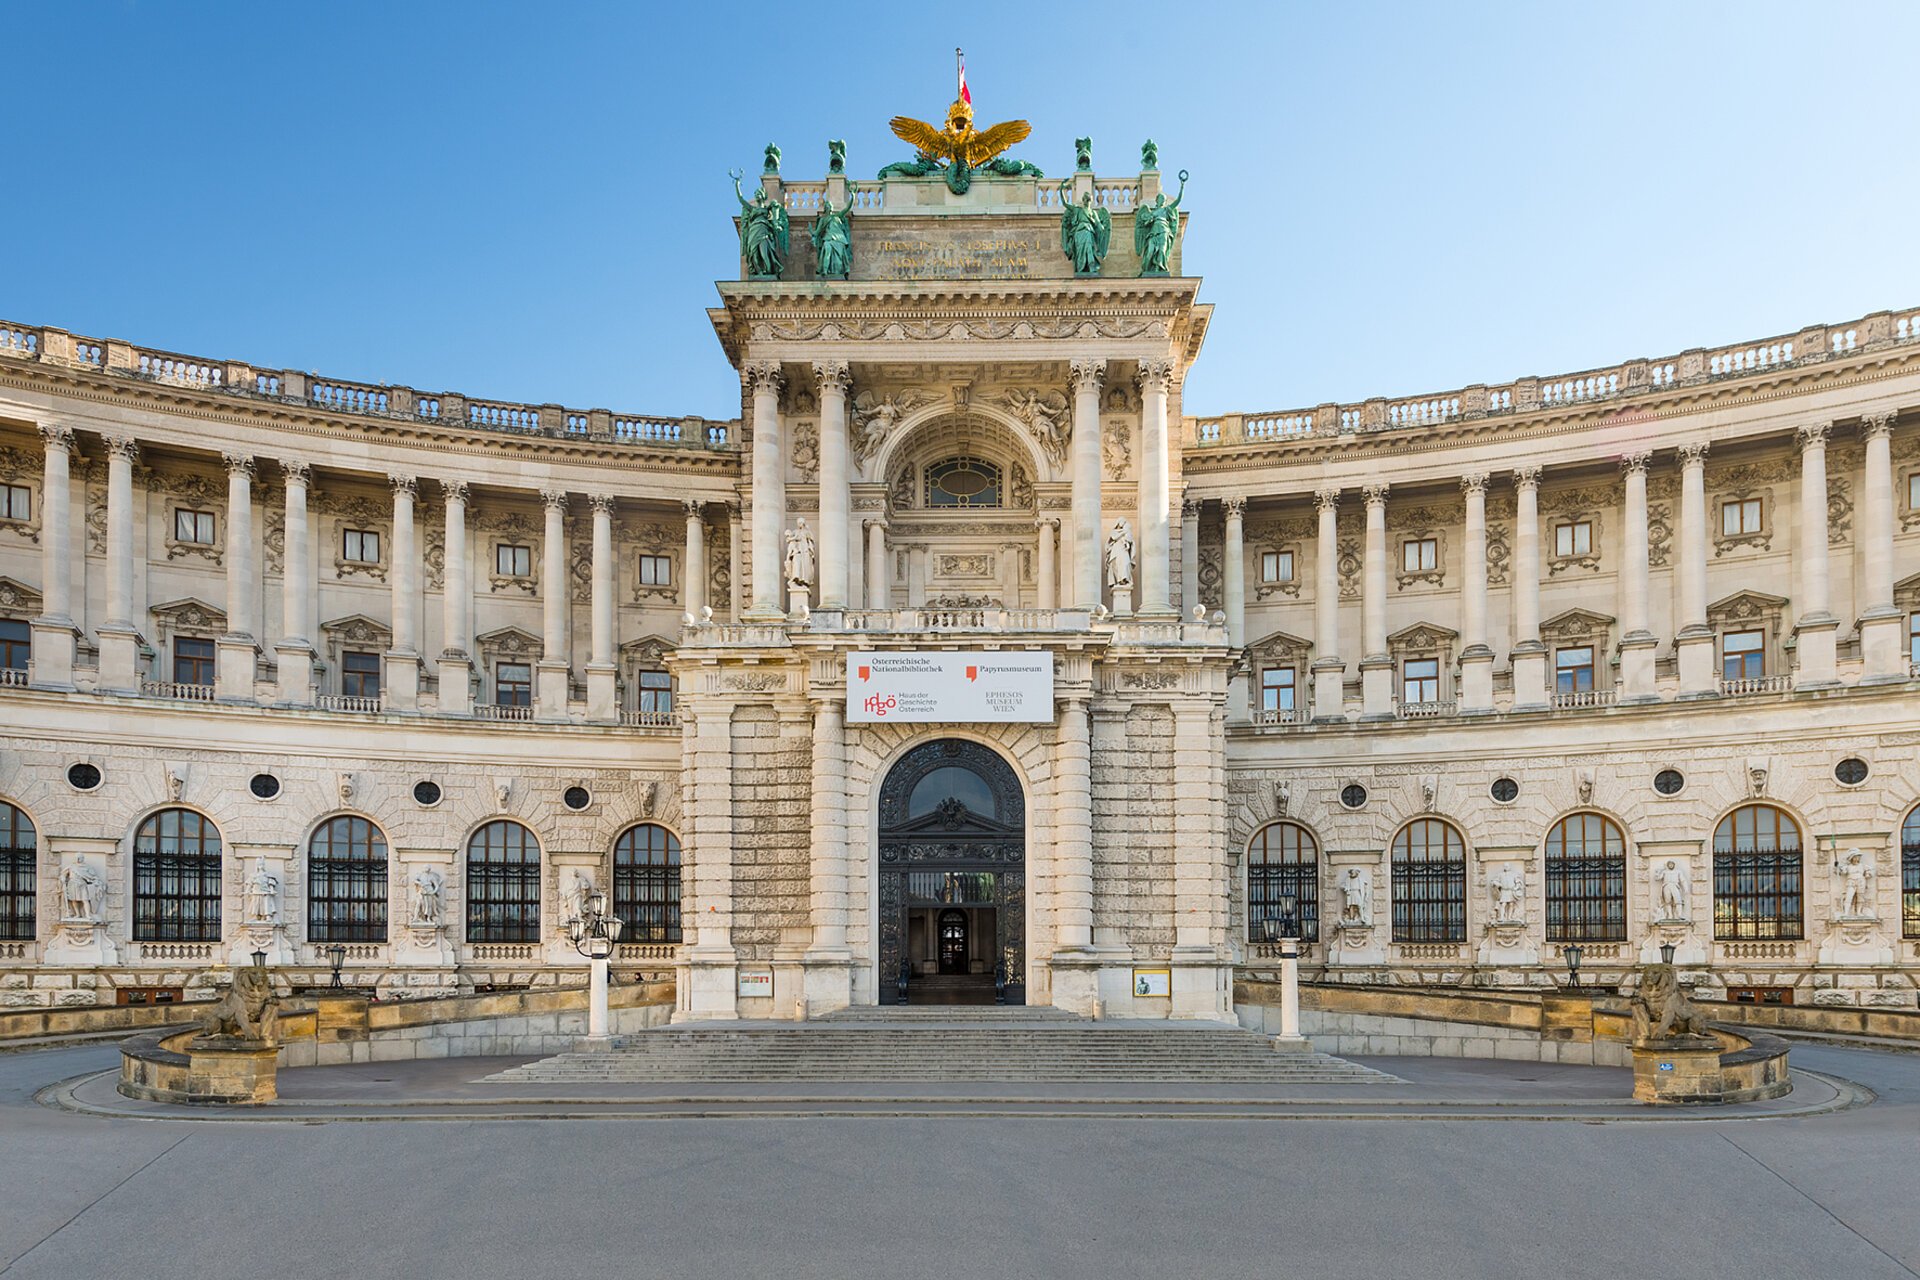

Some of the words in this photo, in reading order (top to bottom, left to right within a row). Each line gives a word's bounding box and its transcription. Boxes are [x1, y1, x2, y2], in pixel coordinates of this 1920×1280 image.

[871, 665, 944, 673] Nationalbibliothek
[980, 665, 1042, 674] Papyrusmuseum
[985, 691, 1024, 699] EPHESOS
[985, 698, 1023, 706] MUSEUM
[992, 705, 1016, 713] WIEN
